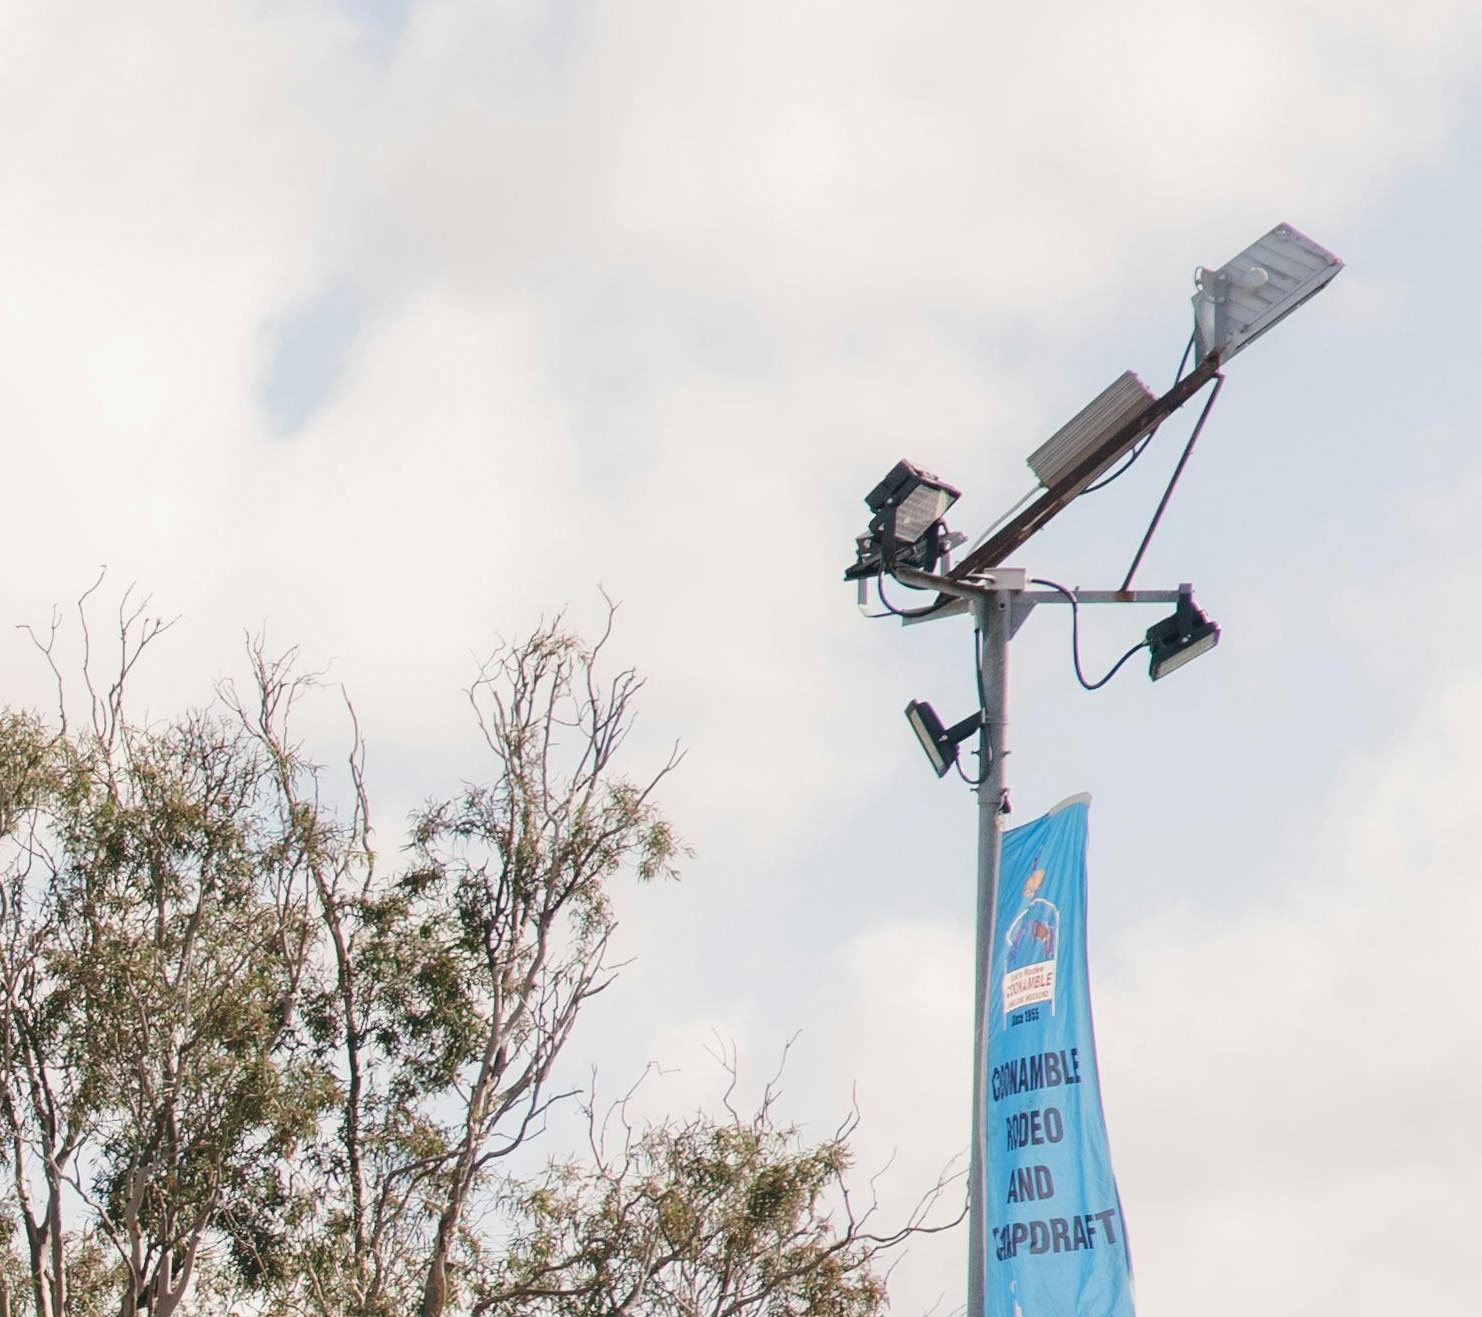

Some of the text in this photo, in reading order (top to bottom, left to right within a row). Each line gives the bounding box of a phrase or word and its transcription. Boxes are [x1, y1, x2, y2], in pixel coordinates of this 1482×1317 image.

[1006, 1107, 1063, 1152] RODEO
[1006, 1164, 1055, 1204] AND
[992, 1208, 1116, 1262] CPDRAFT
